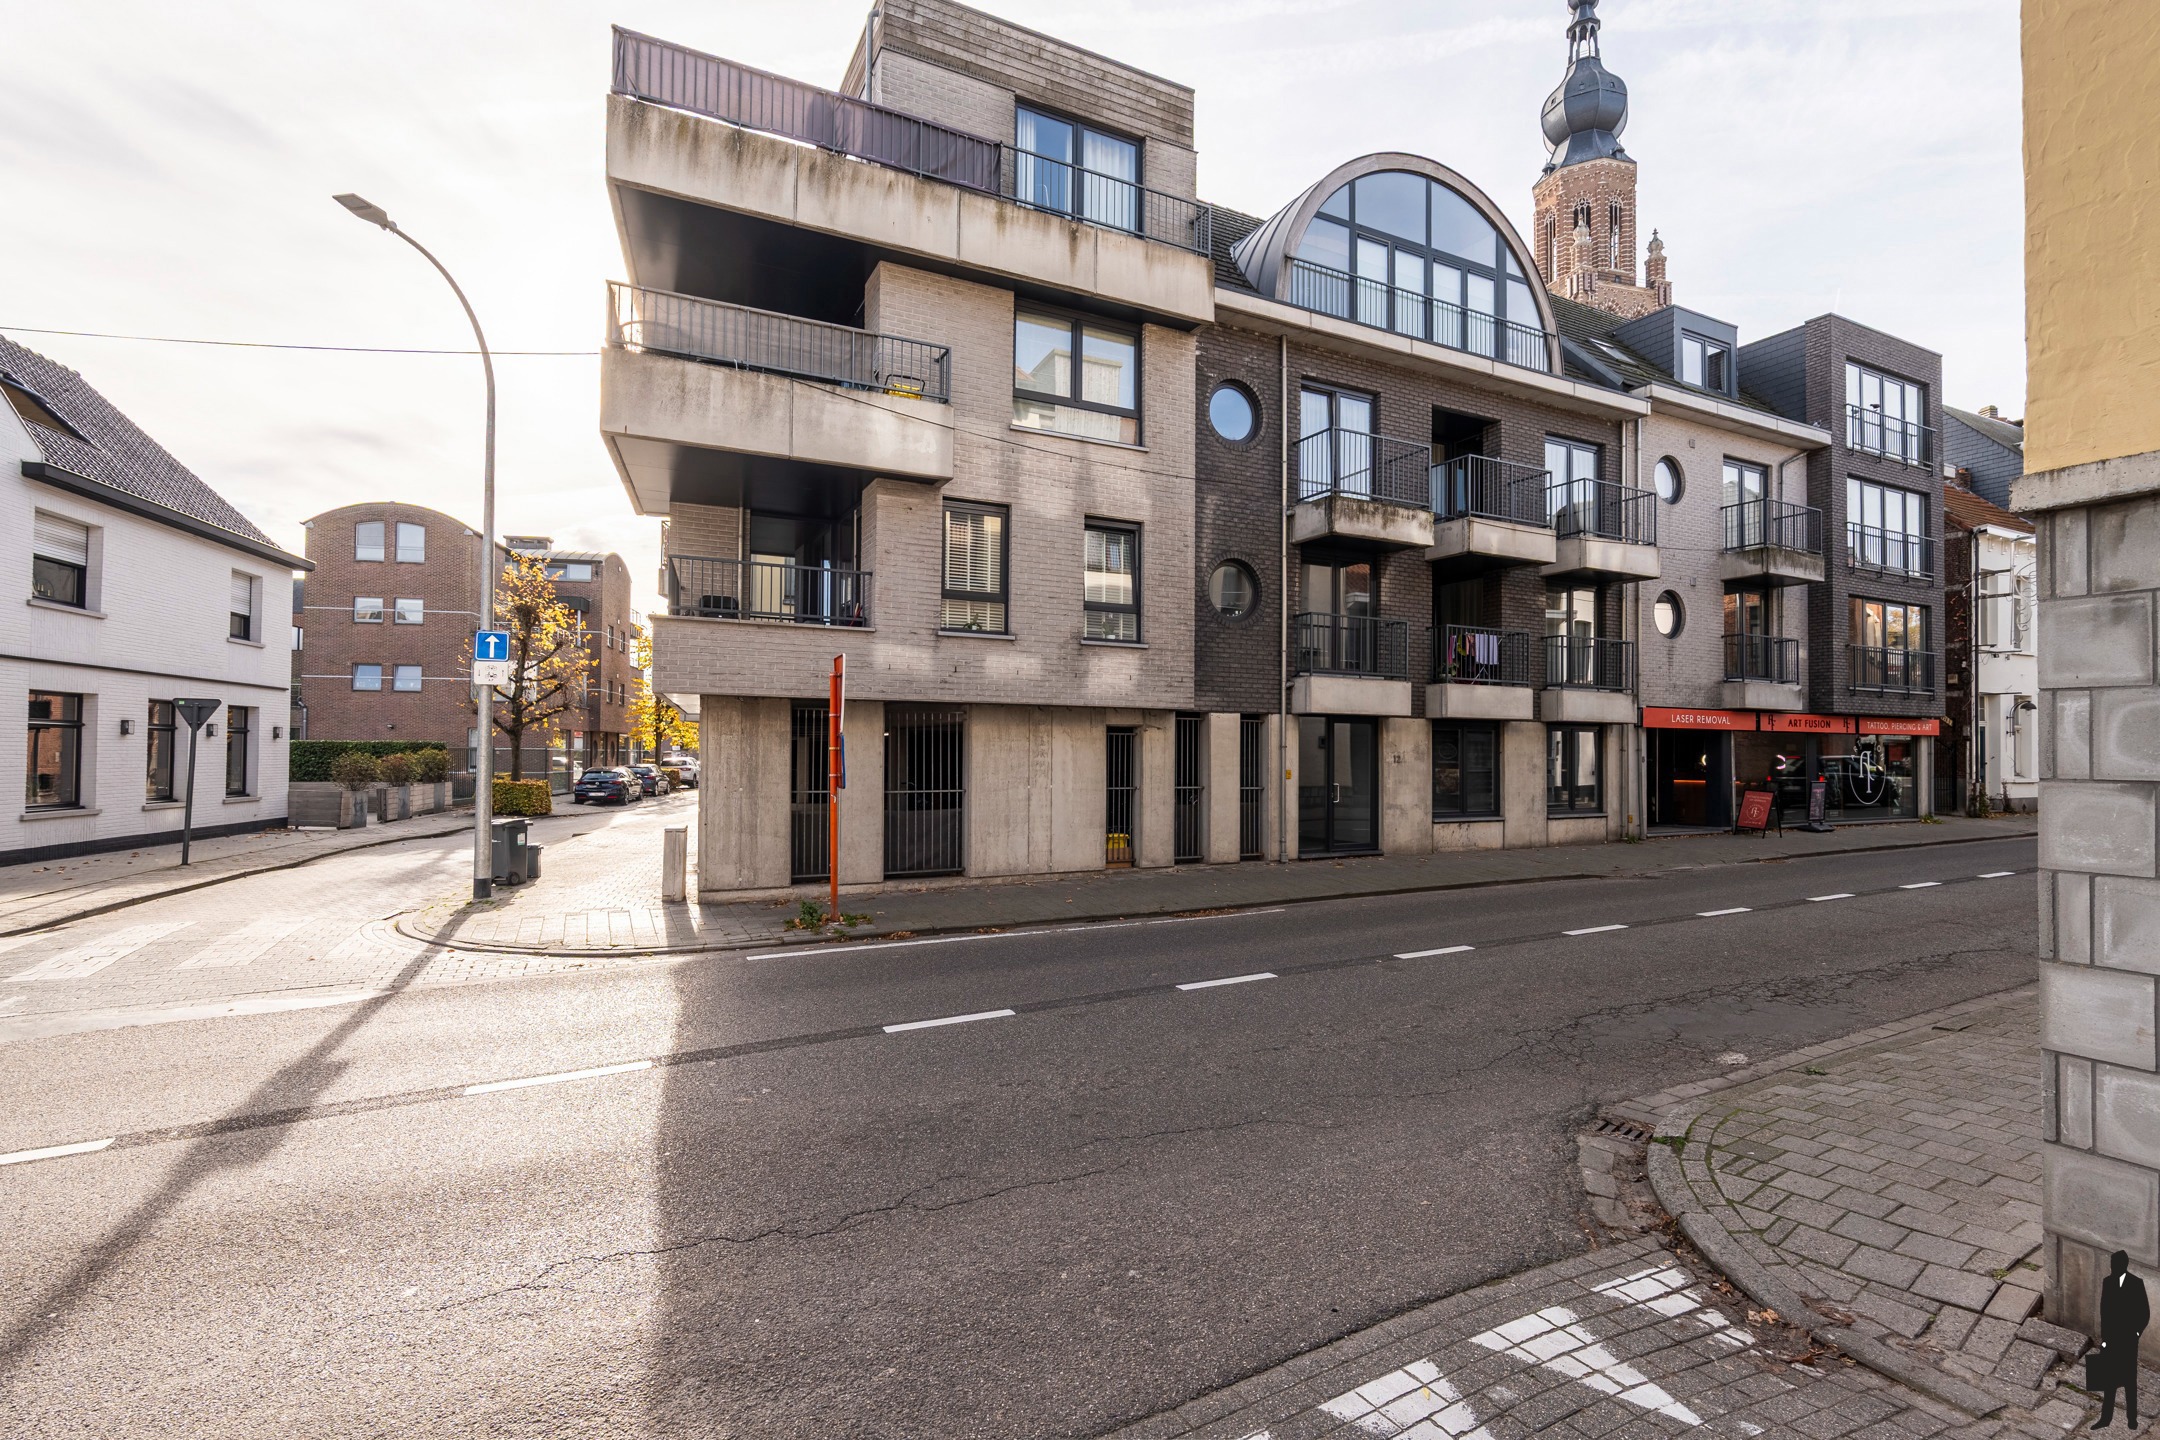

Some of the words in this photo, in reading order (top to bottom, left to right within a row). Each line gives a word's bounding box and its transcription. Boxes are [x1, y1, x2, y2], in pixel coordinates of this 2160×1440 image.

[1671, 714, 1694, 724] LASER
[1697, 715, 1731, 725] REMOVAL
[1788, 719, 1802, 728] ART
[1805, 719, 1831, 729] FUSION
[1891, 722, 1916, 731] PIERCING
[1922, 723, 1932, 731] ART
